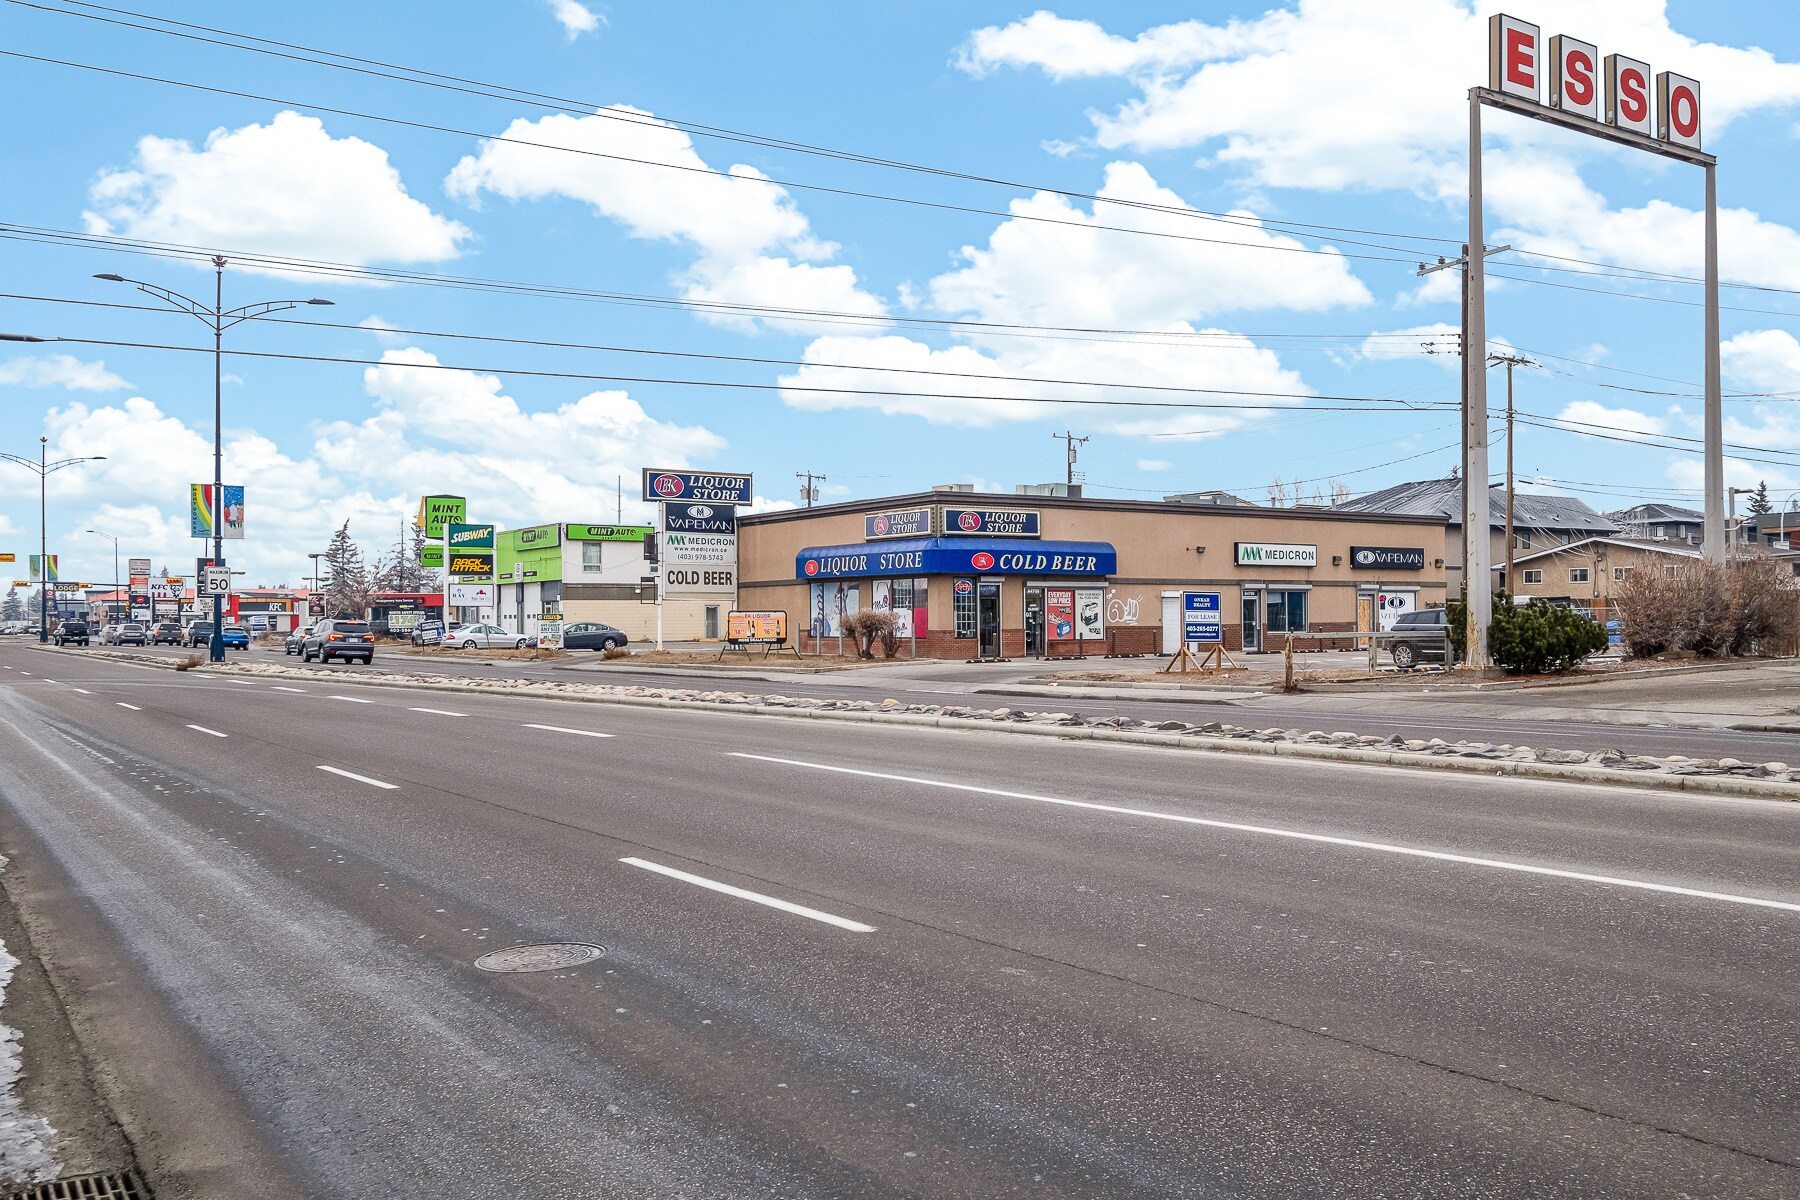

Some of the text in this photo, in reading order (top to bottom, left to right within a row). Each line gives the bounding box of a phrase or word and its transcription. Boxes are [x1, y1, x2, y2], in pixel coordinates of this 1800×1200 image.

[1507, 27, 1698, 138] ESSO
[689, 475, 745, 490] LIQUOR
[692, 488, 740, 500] STORE
[432, 504, 461, 513] MINT
[431, 515, 462, 524] AUTO
[891, 512, 921, 525] LIQUOR
[985, 512, 1027, 524] LIQUOR
[590, 527, 612, 535] MINT
[668, 519, 732, 531] VAPEMAN
[891, 523, 918, 534] STORE
[986, 523, 1023, 533] STORE
[450, 527, 492, 543] SUBWAY
[522, 530, 536, 542] MINT
[688, 537, 735, 546] MEDICRON
[1265, 549, 1314, 561] MEDICRON
[1375, 552, 1423, 564] VAPEMAN
[451, 564, 491, 572] ATTACK
[453, 558, 482, 566] RACK
[820, 555, 868, 575] LIQUOR
[880, 552, 923, 570] STORE
[1000, 554, 1047, 570] COLD
[1051, 555, 1097, 571] BEER
[667, 570, 733, 585] COLD BEER
[209, 579, 228, 591] 50
[268, 603, 282, 611] KFC
